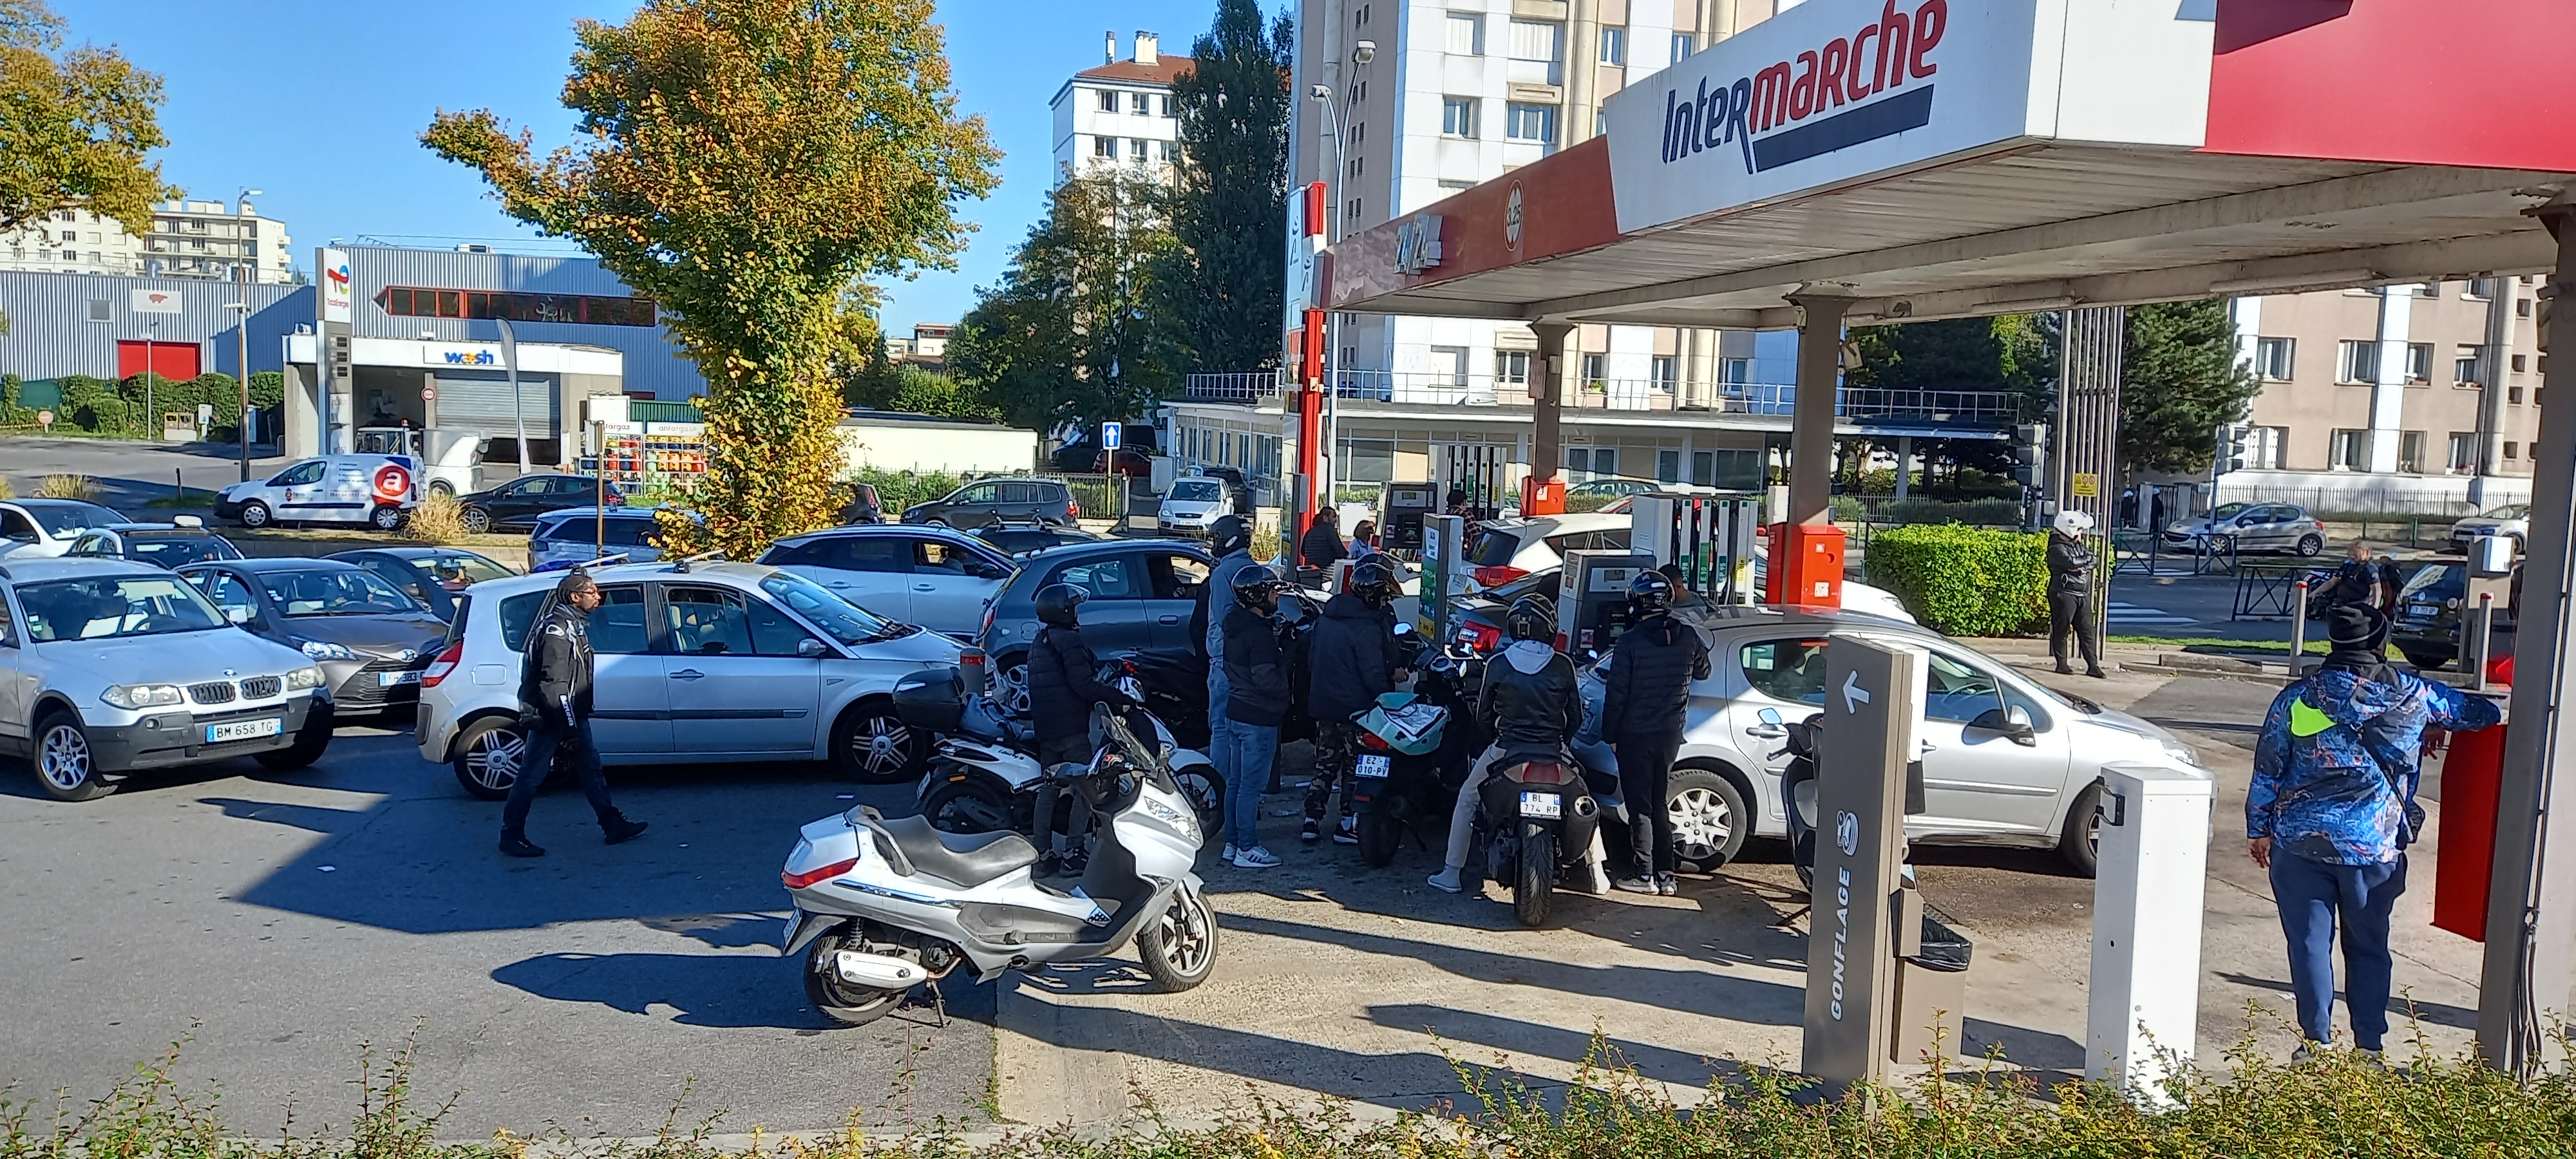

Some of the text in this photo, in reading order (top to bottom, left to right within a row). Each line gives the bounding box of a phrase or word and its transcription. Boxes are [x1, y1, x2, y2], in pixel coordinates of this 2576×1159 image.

[1506, 203, 1522, 227] 3.25
[444, 349, 494, 365] wash
[658, 425, 693, 433] antargaz
[216, 721, 273, 739] BM 658 TG
[1532, 794, 1543, 803] BL
[1524, 804, 1558, 815] 774 RP
[1830, 866, 1852, 1021] GONFLAGE
